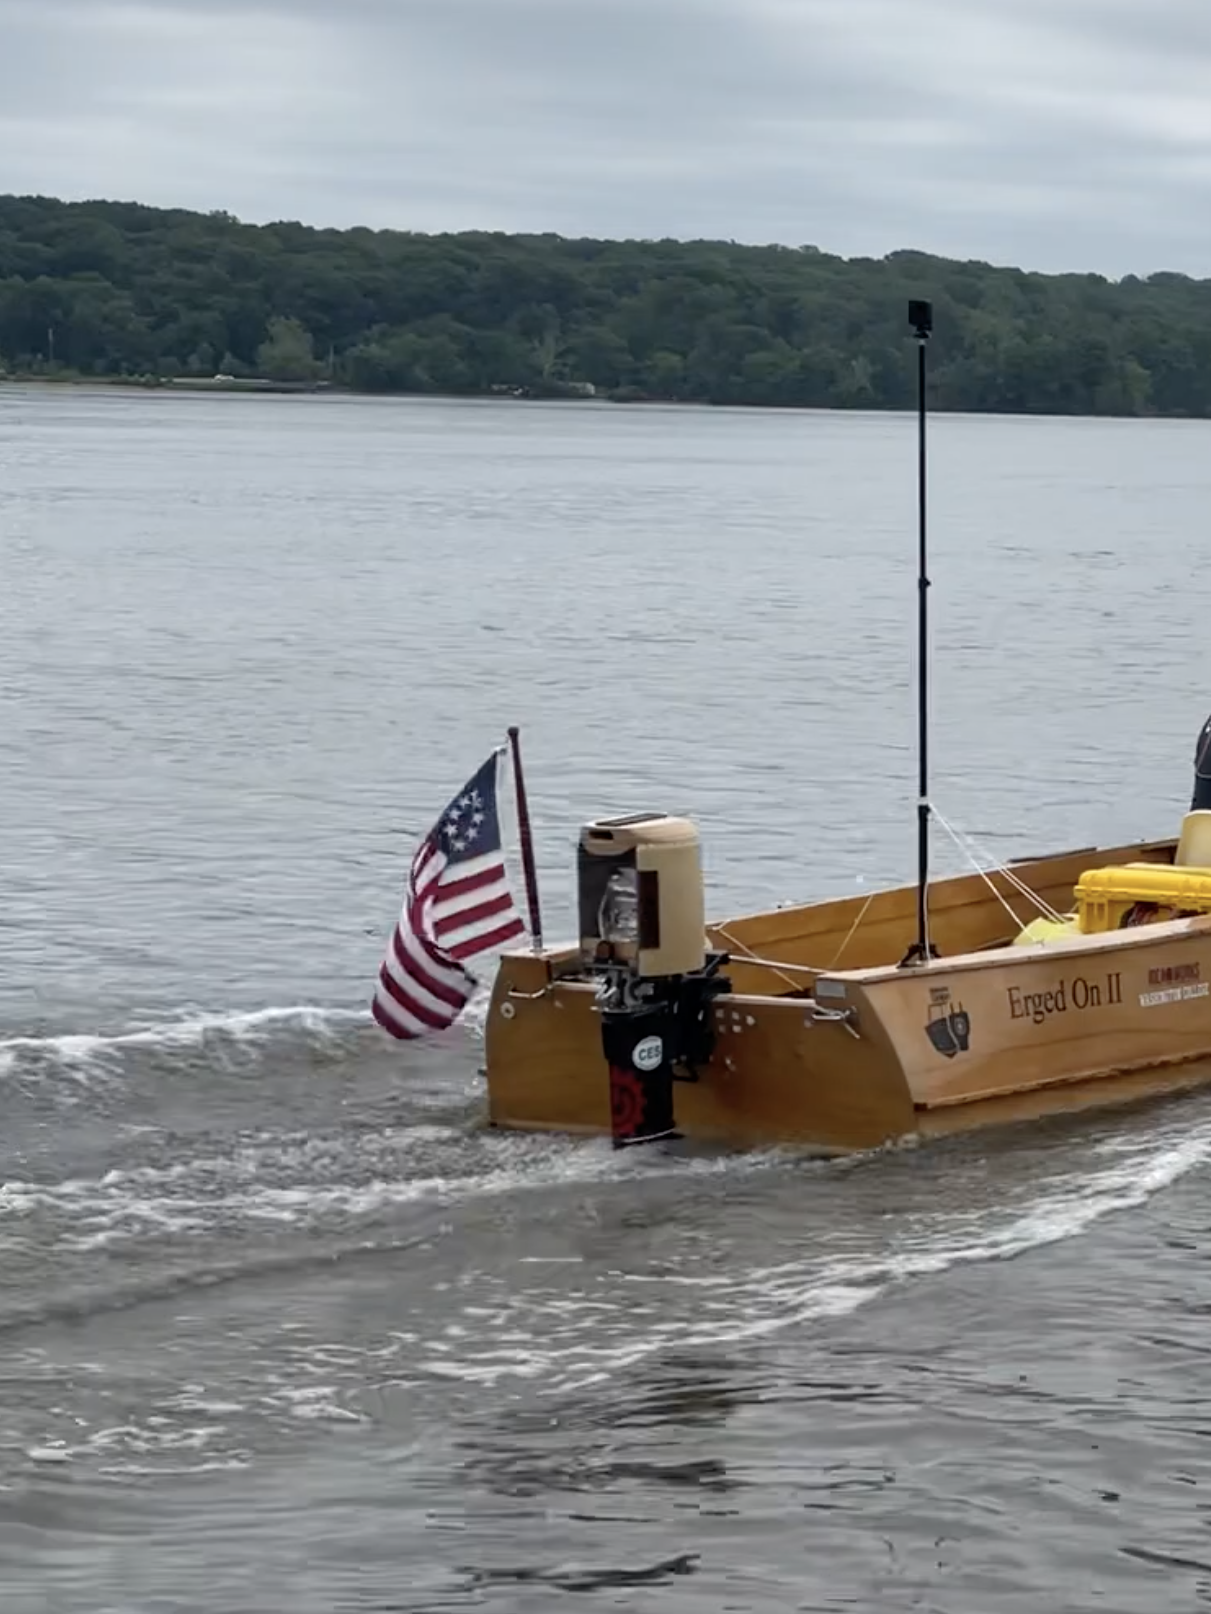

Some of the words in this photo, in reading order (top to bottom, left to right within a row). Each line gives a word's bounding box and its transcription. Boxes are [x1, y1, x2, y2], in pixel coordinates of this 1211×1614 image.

[1007, 979, 1067, 1025] Erged
[1072, 976, 1101, 1008] On
[1107, 972, 1123, 1005] II
[638, 1045, 662, 1062] CES
